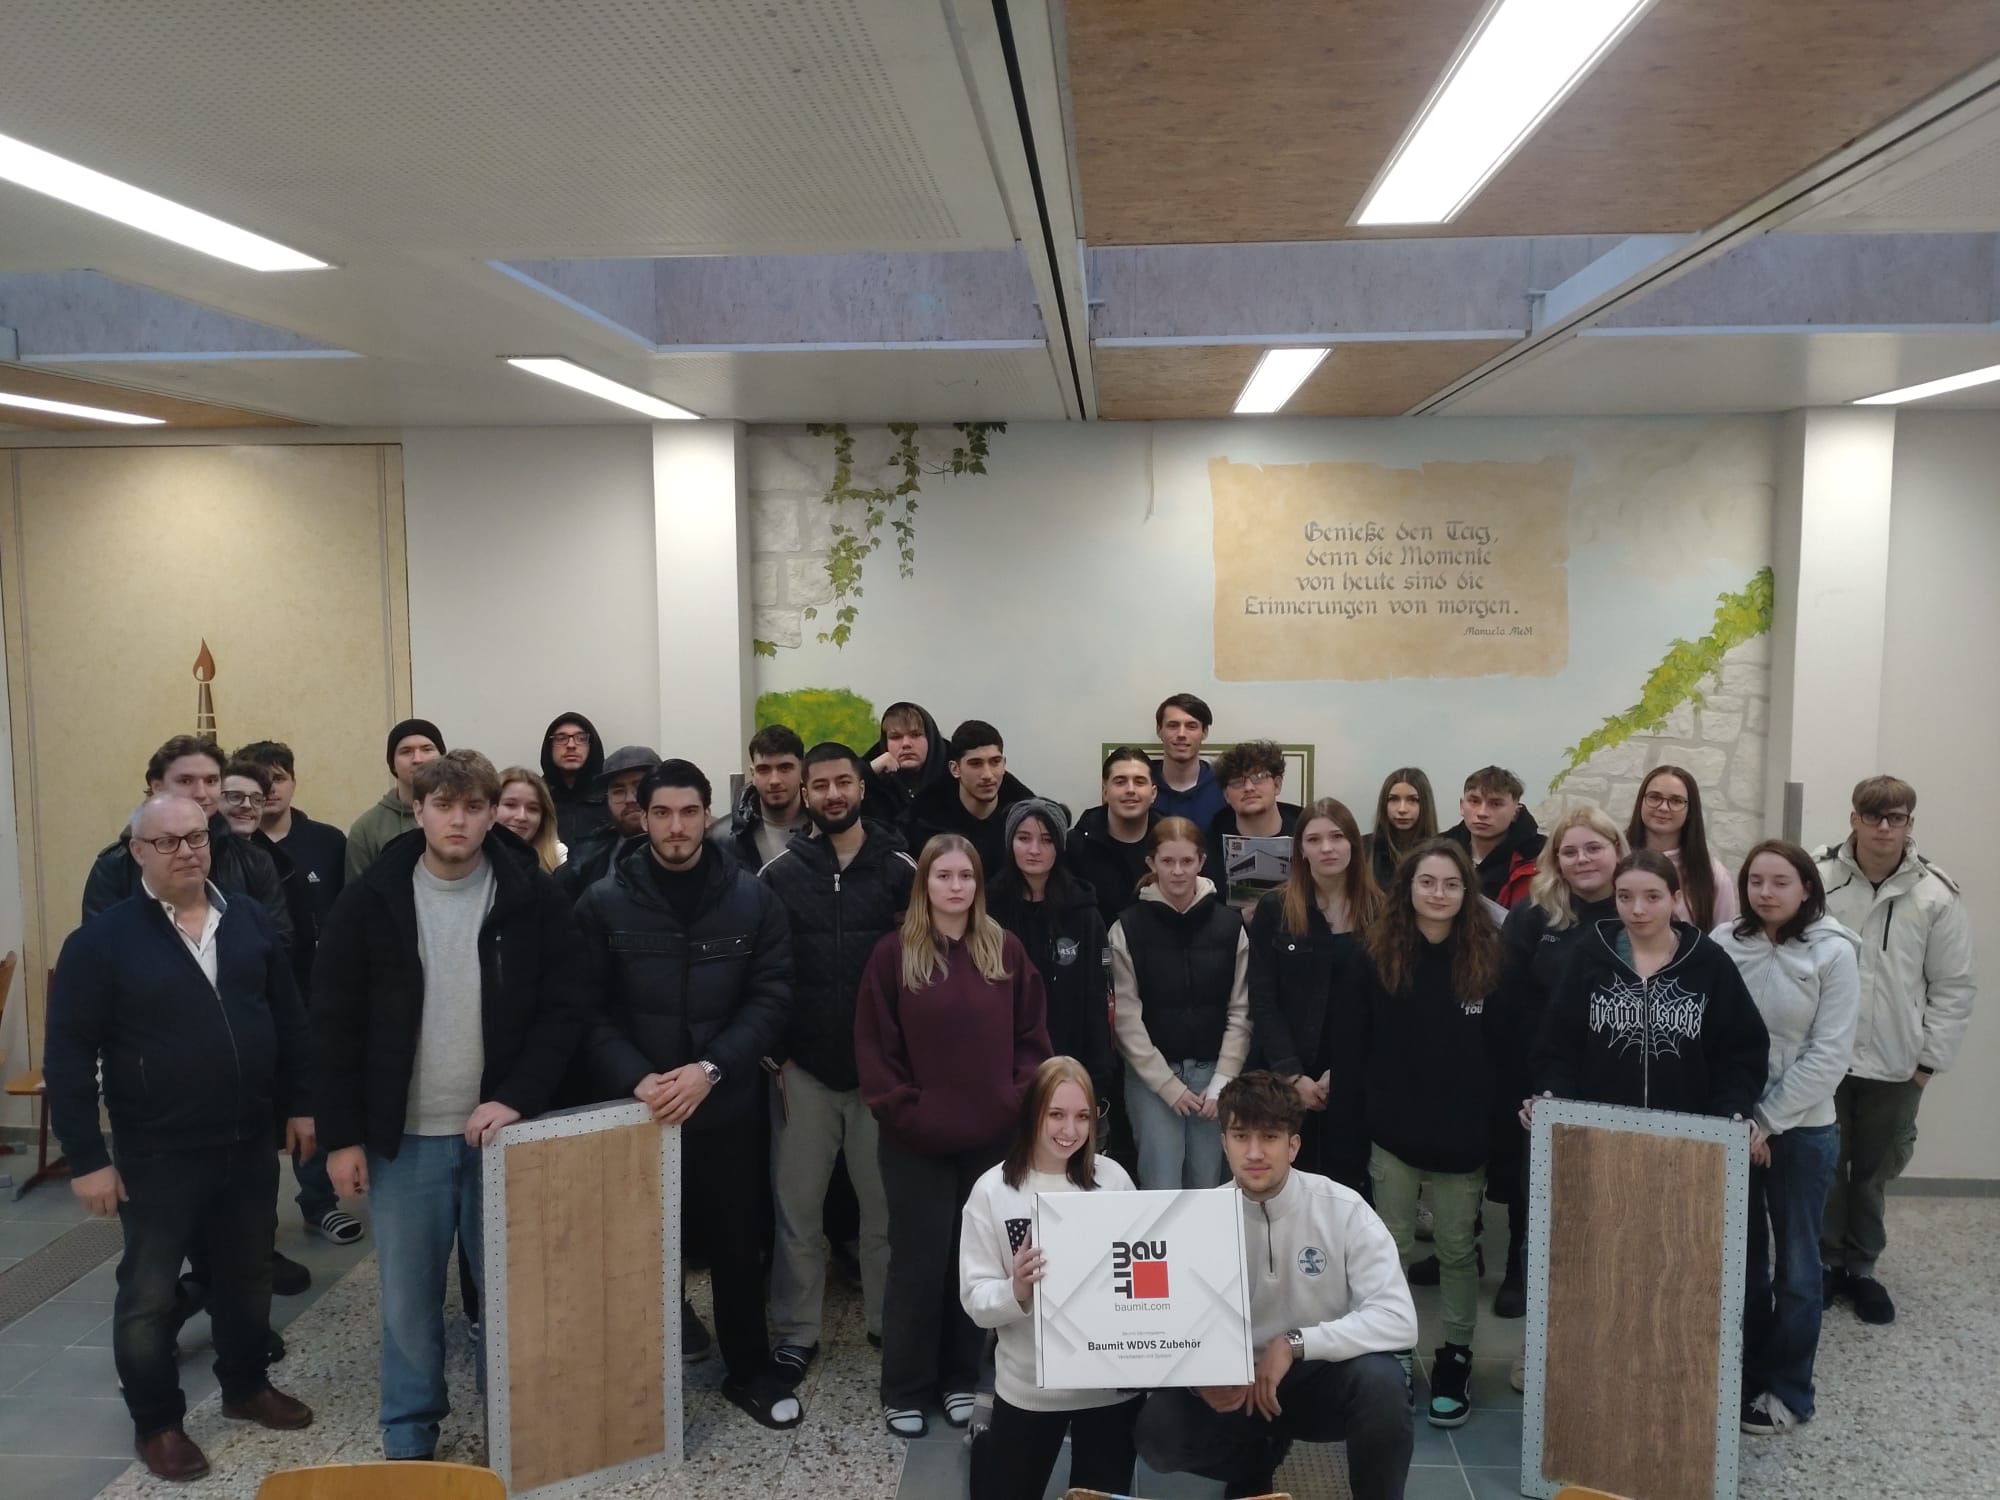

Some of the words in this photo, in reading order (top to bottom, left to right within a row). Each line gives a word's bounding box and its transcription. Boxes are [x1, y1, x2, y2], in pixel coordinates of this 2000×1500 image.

[1395, 521, 1433, 541] den
[1445, 520, 1499, 545] Tag,
[1305, 548, 1358, 566] denn
[1365, 547, 1393, 566] die
[1400, 546, 1492, 566] Momente
[1295, 574, 1335, 591] von
[1343, 571, 1395, 593] heute
[1404, 571, 1447, 591] sind
[1456, 571, 1484, 590] die
[1244, 596, 1377, 619] Erinnerungen
[1389, 599, 1428, 615] von
[1438, 599, 1519, 619] morgen.
[1115, 1301, 1171, 1312] baumit.com
[1087, 1341, 1124, 1351] Baumit
[1126, 1340, 1157, 1350] WDVS
[1159, 1338, 1201, 1349] Zubehör
